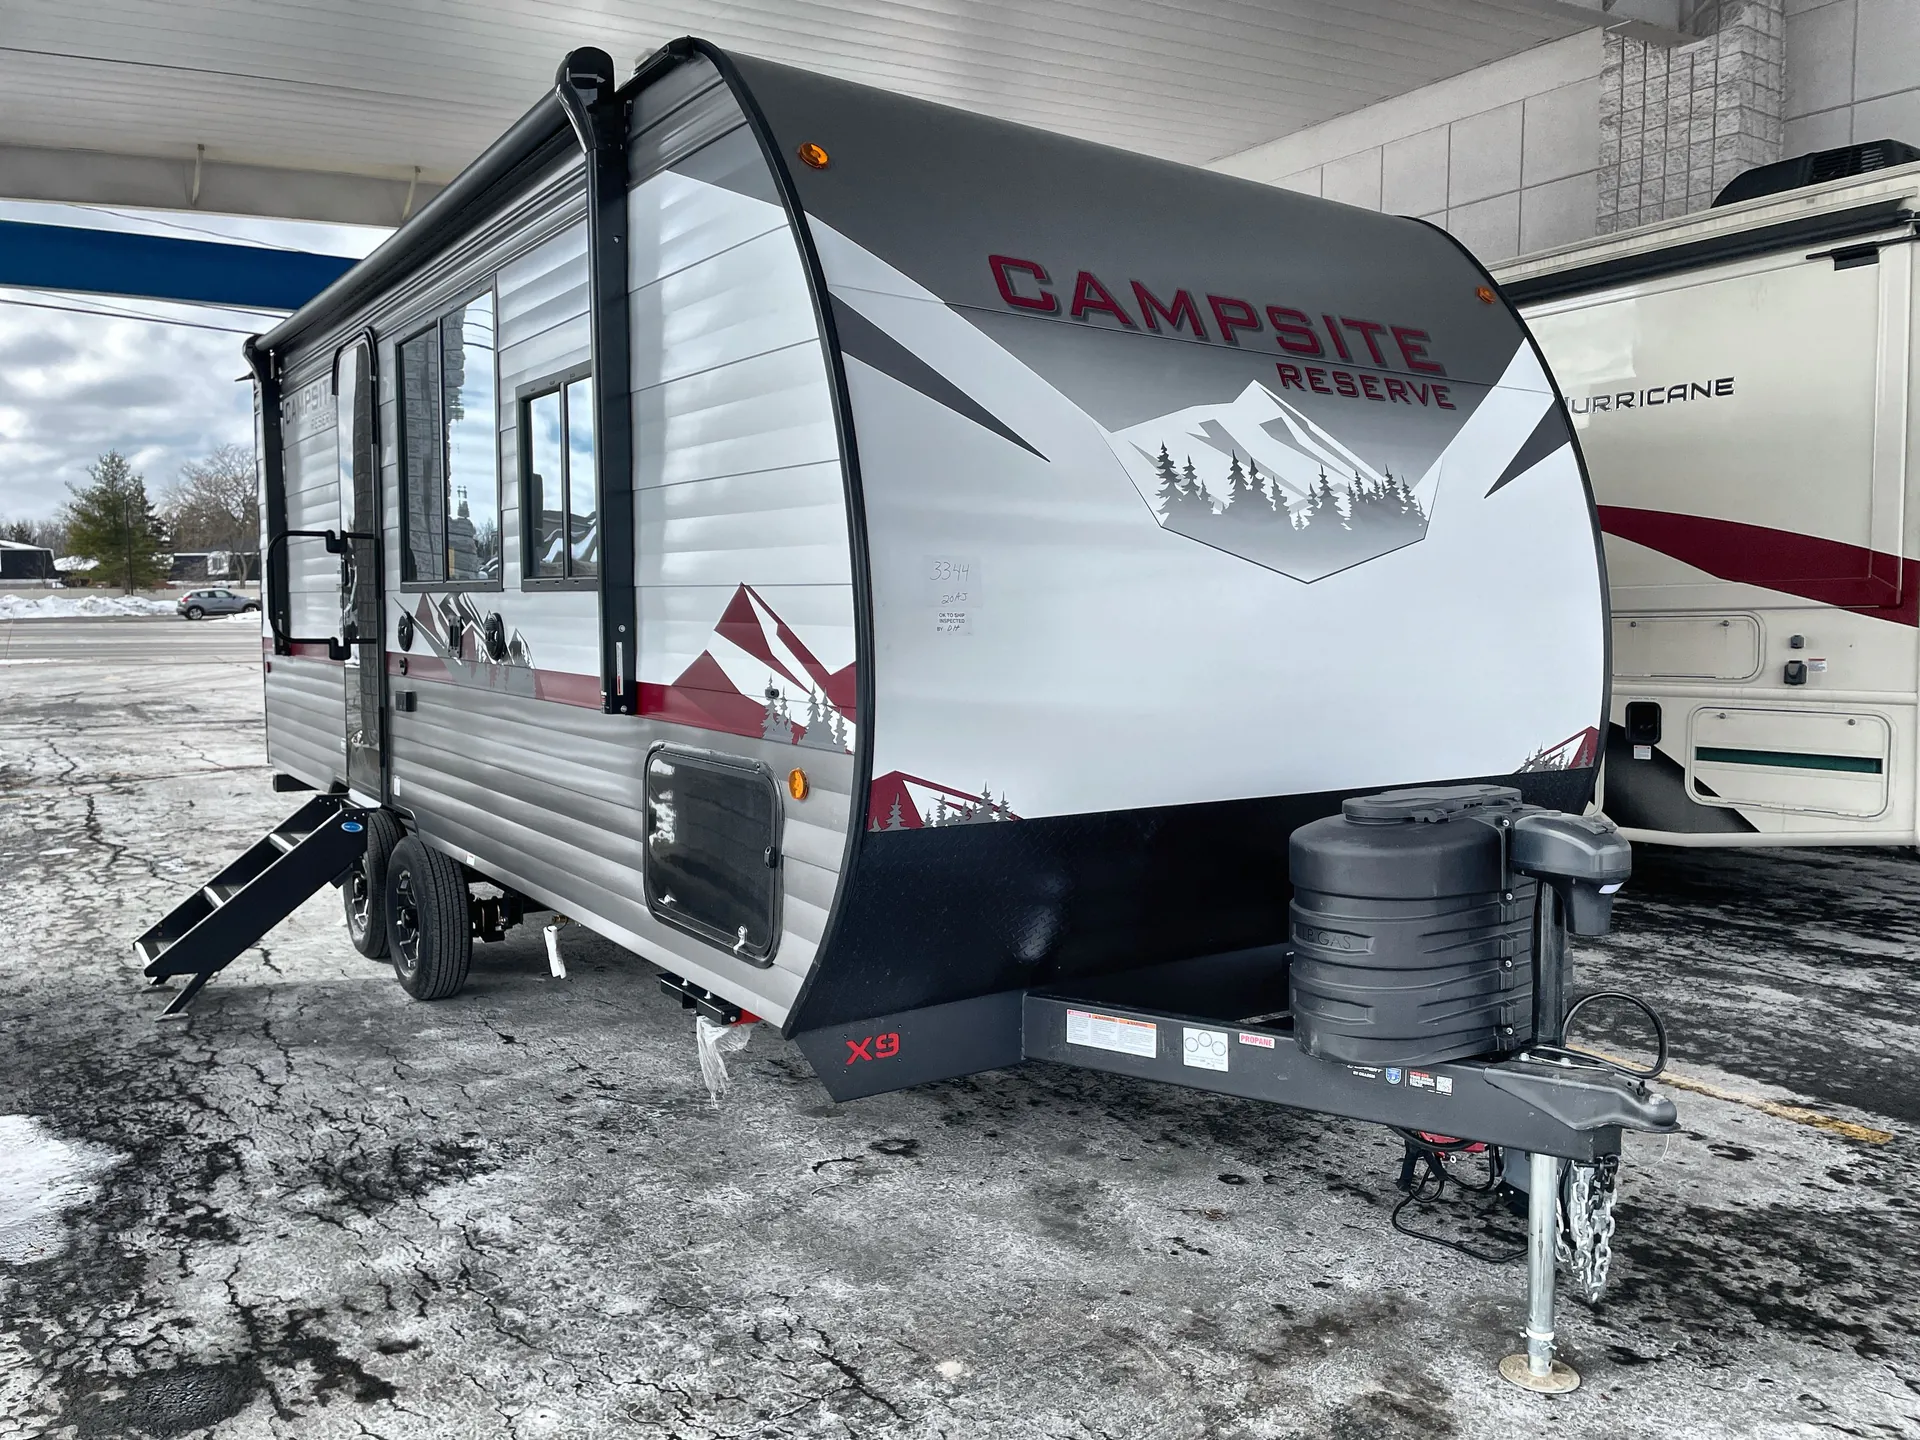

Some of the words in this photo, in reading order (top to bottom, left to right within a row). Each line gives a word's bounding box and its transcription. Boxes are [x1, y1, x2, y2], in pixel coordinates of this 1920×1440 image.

[988, 254, 1446, 374] CAMPSITE
[285, 378, 334, 425] CAMPSIT
[1275, 362, 1456, 410] RESERVE
[929, 560, 970, 582] 3344
[1317, 931, 1351, 949] GAS
[845, 1032, 900, 1067] X9
[1240, 1034, 1273, 1047] PROPANE
